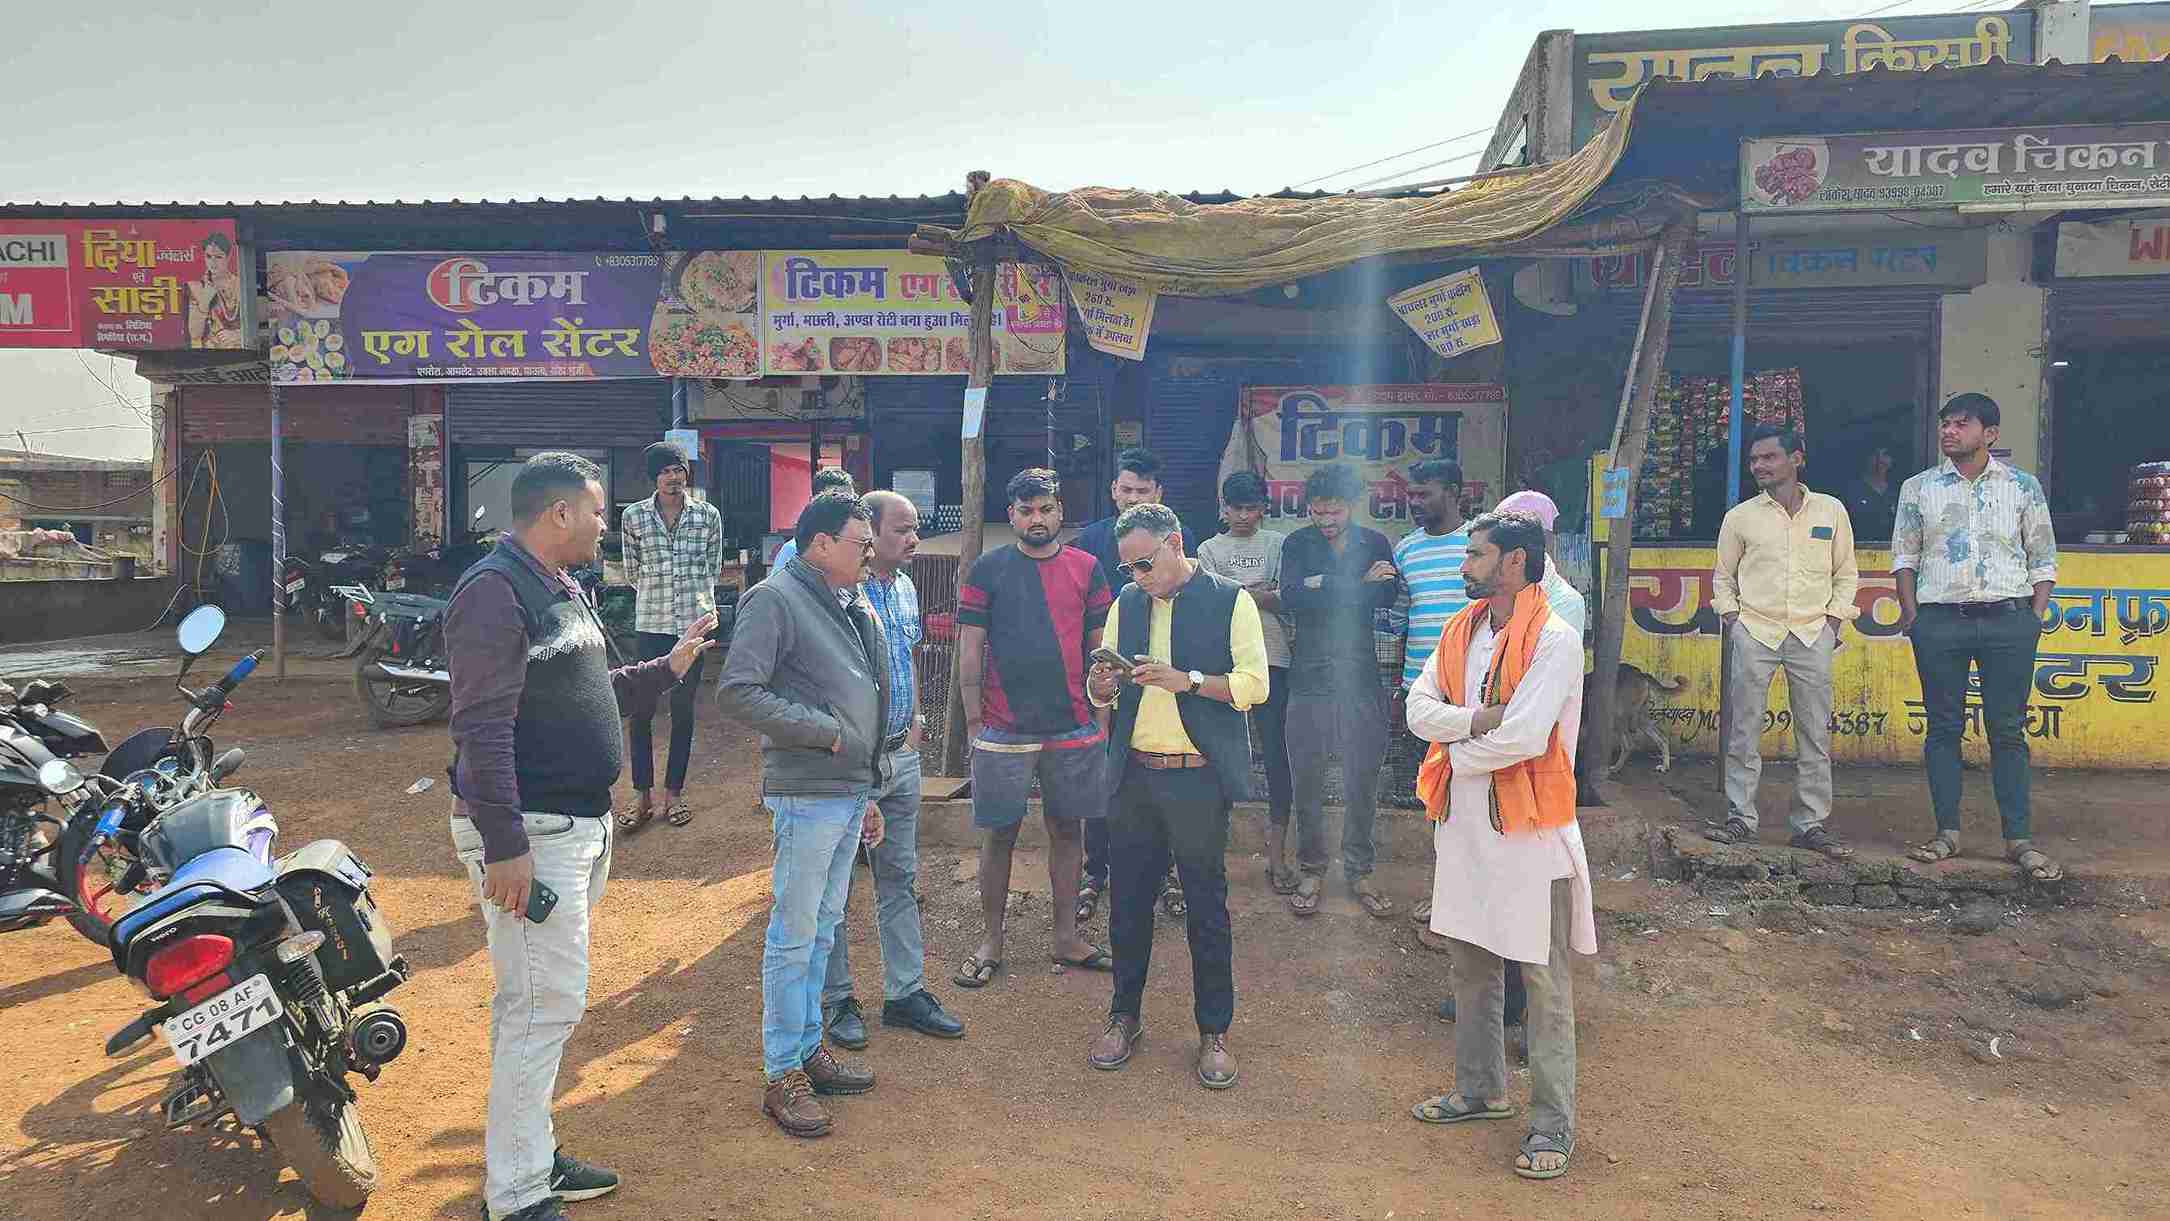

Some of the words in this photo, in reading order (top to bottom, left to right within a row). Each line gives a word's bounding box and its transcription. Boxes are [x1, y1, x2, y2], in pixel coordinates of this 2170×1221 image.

[1864, 142, 2003, 178] यादव
[2012, 134, 2158, 173] चिकन
[81, 229, 157, 273] दिया
[88, 276, 183, 321] साड़ी
[441, 260, 590, 306] टिकम
[784, 256, 889, 300] टिकम
[361, 328, 433, 365] एग
[444, 318, 529, 359] रोल
[541, 316, 641, 359] सेंटर
[950, 311, 969, 327] मिल
[1277, 391, 1464, 461] टिकम
[177, 998, 278, 1060] 7471
[181, 1012, 207, 1032] CG
[209, 1000, 230, 1017] 08
[234, 985, 255, 1004] AF
